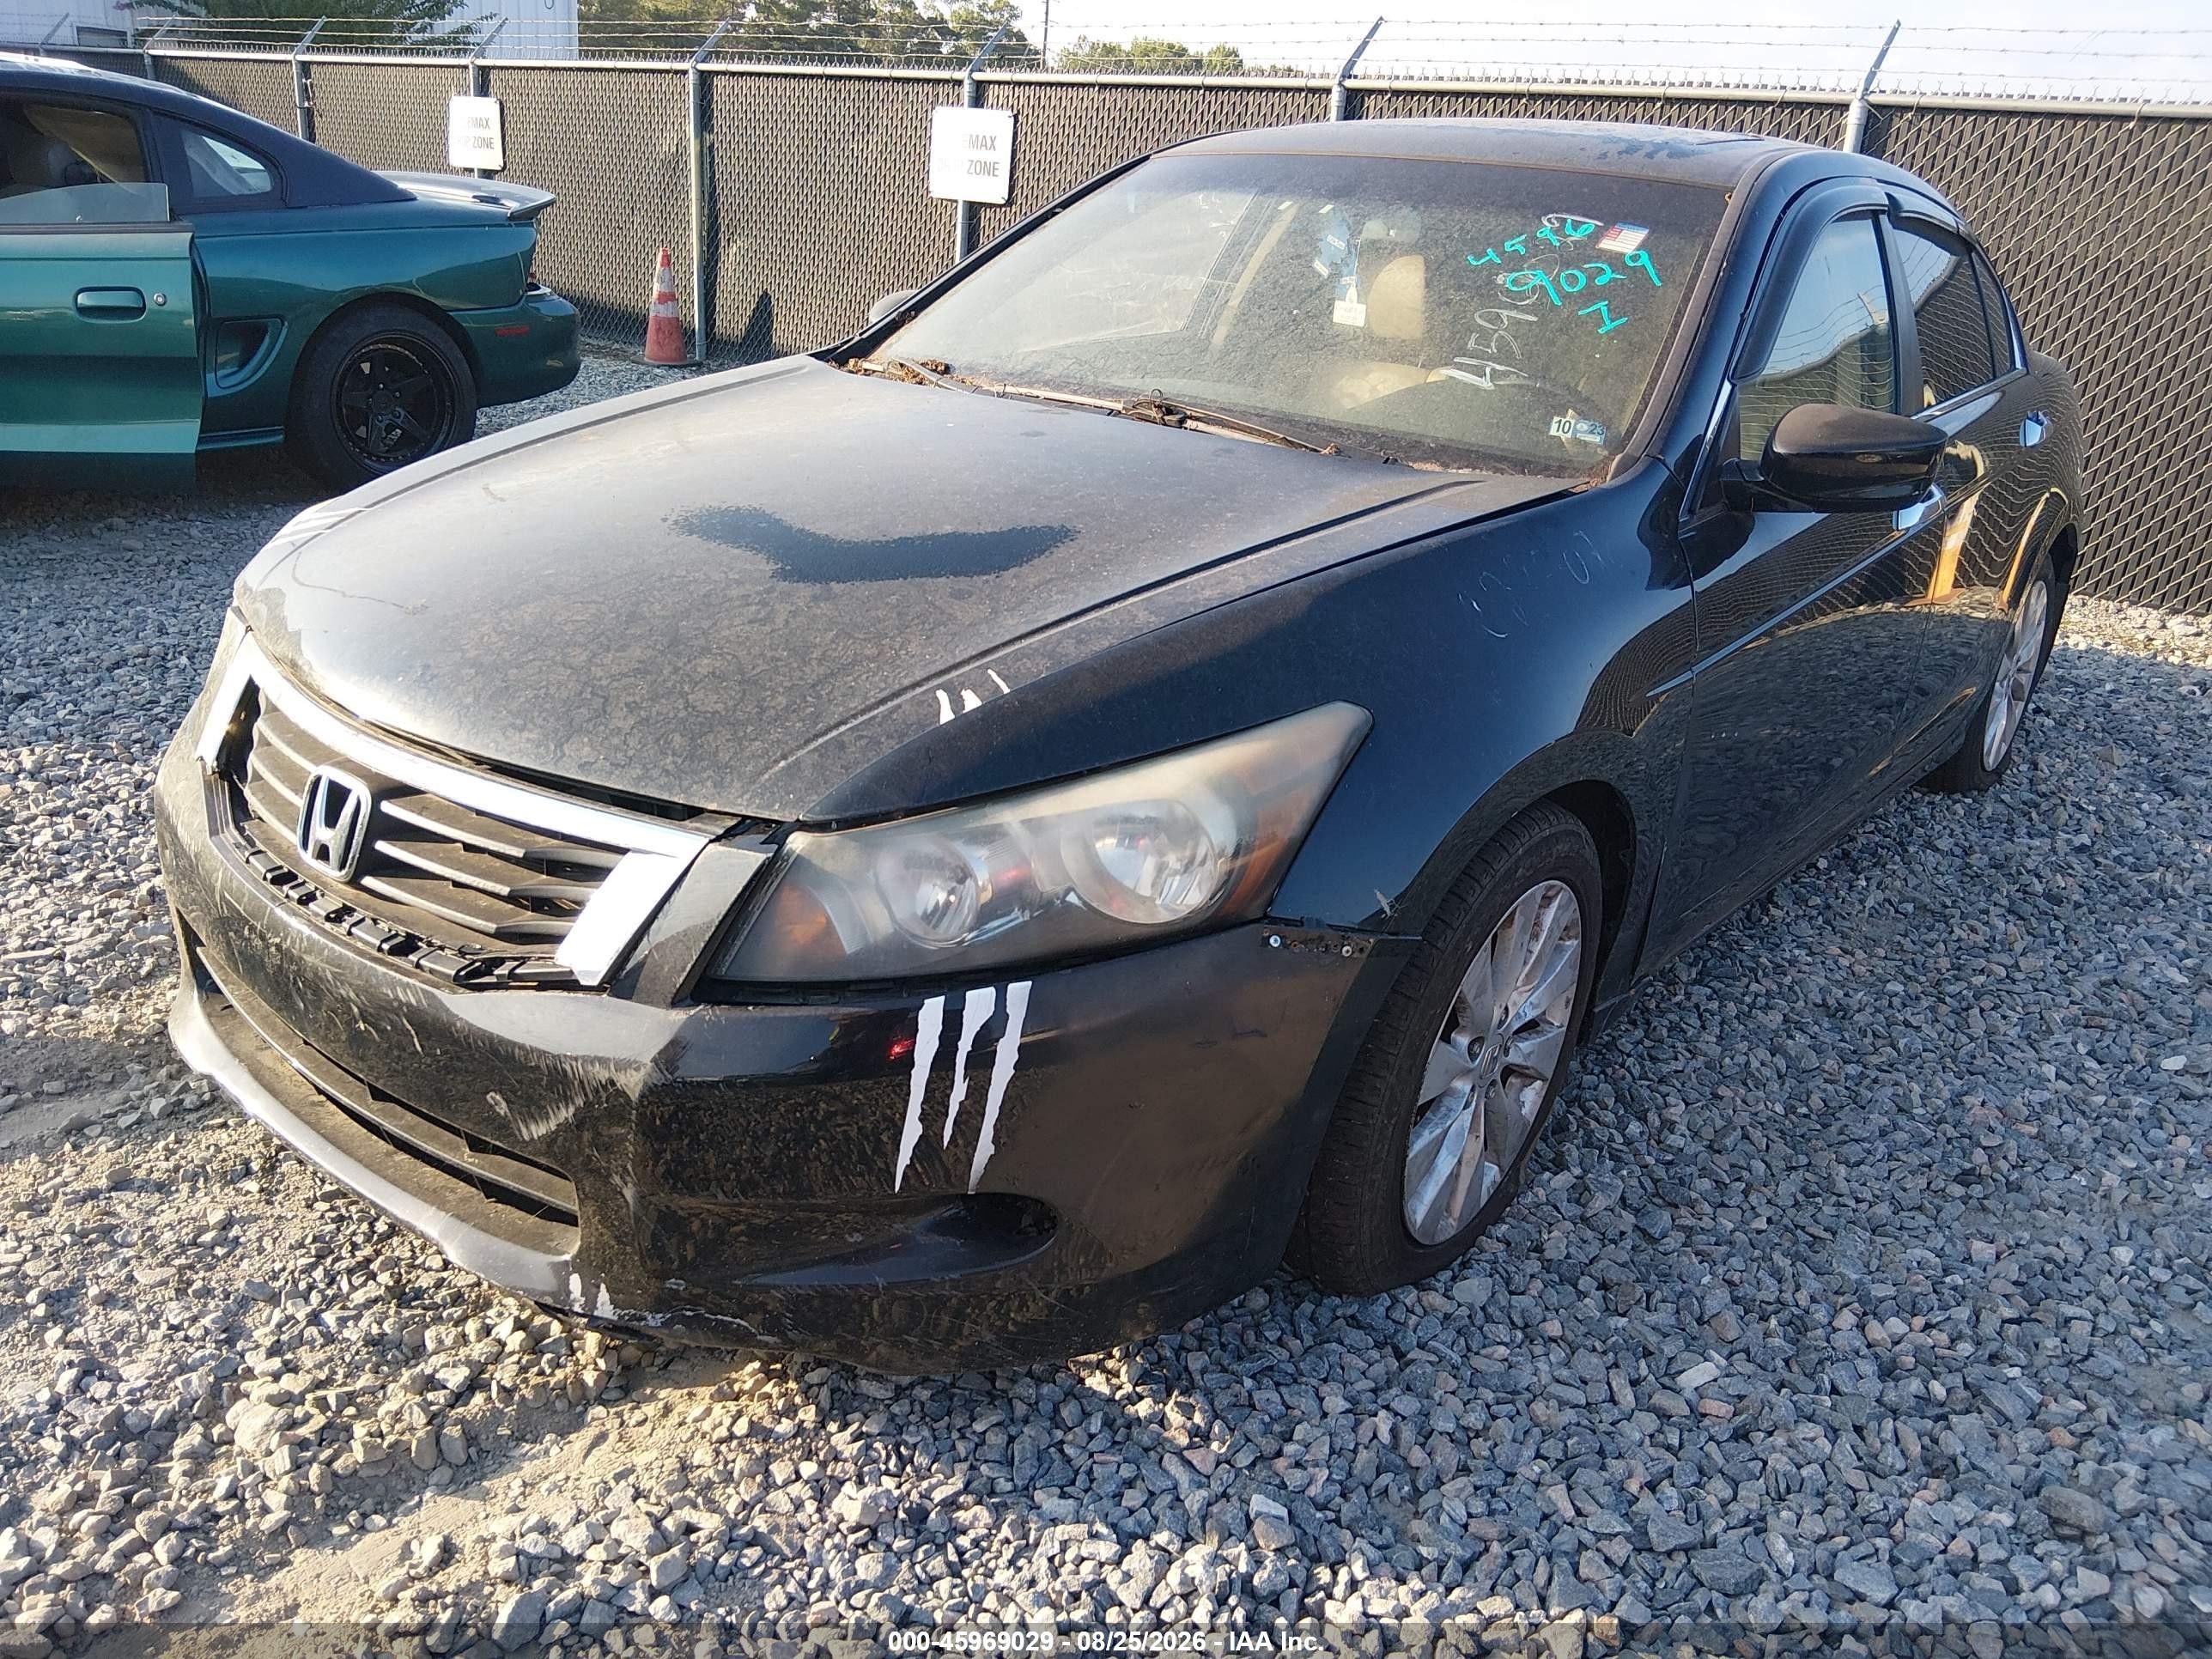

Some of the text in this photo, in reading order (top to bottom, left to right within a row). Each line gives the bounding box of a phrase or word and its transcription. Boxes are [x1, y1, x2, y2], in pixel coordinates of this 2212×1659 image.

[472, 136, 495, 150] ZONE
[967, 159, 1000, 177] ZONE
[1505, 249, 1662, 307] 9029
[1554, 419, 1605, 436] 10 23
